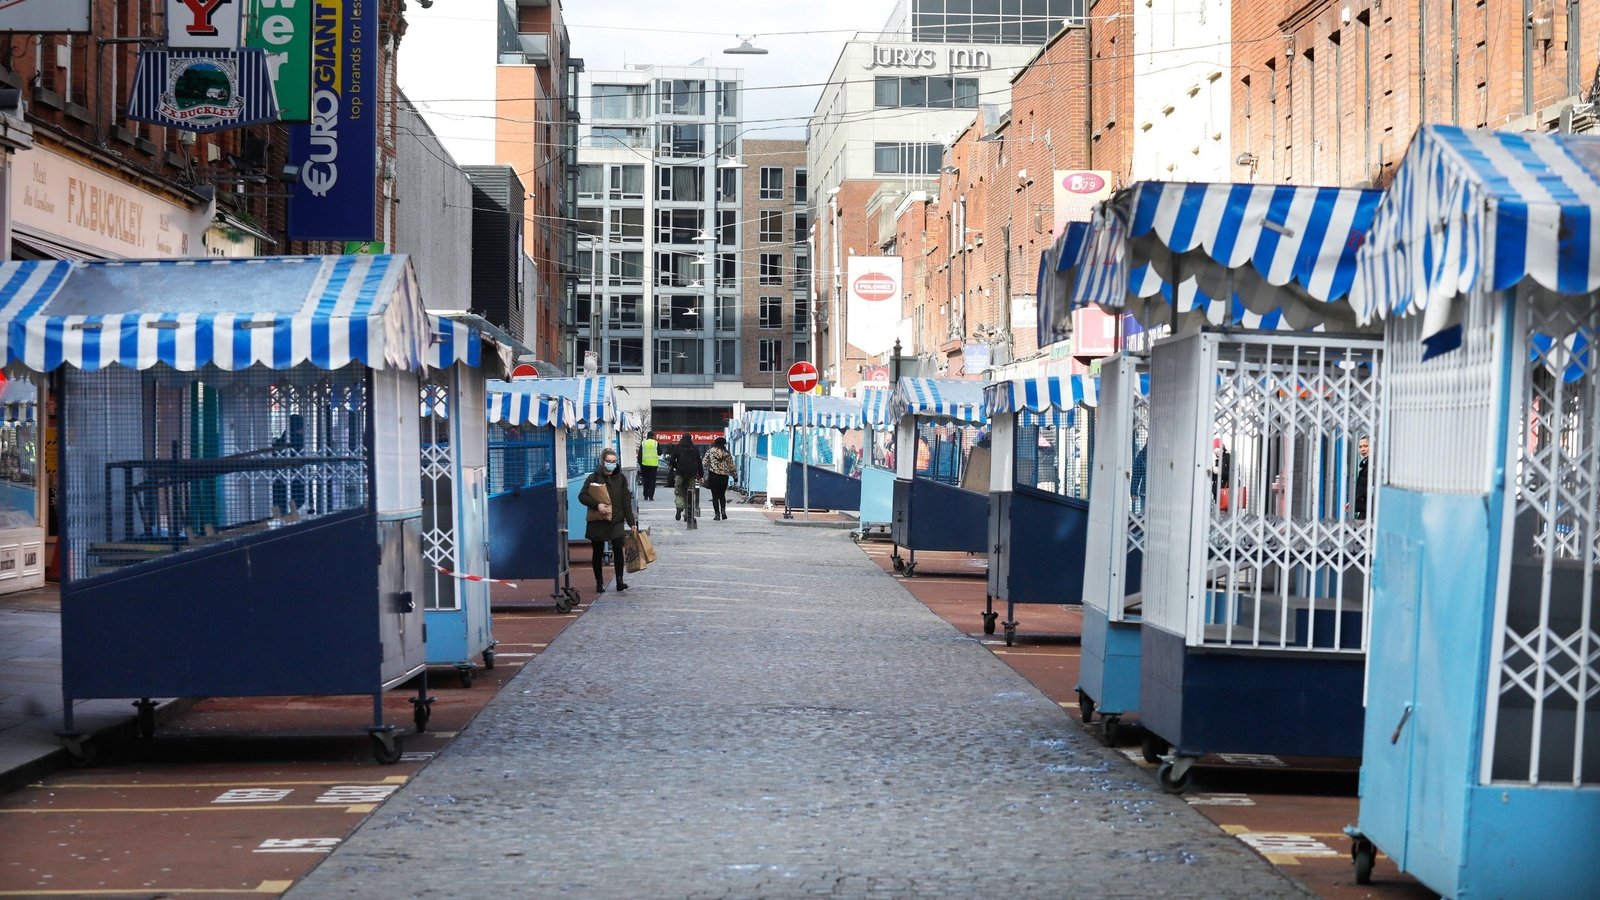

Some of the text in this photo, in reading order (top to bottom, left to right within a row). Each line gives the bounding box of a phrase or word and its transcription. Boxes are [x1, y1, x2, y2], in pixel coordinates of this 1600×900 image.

[258, 0, 295, 81] er
[349, 28, 361, 46] for
[349, 48, 361, 93] brands
[863, 43, 990, 75] JURYS Inn
[350, 98, 363, 119] top
